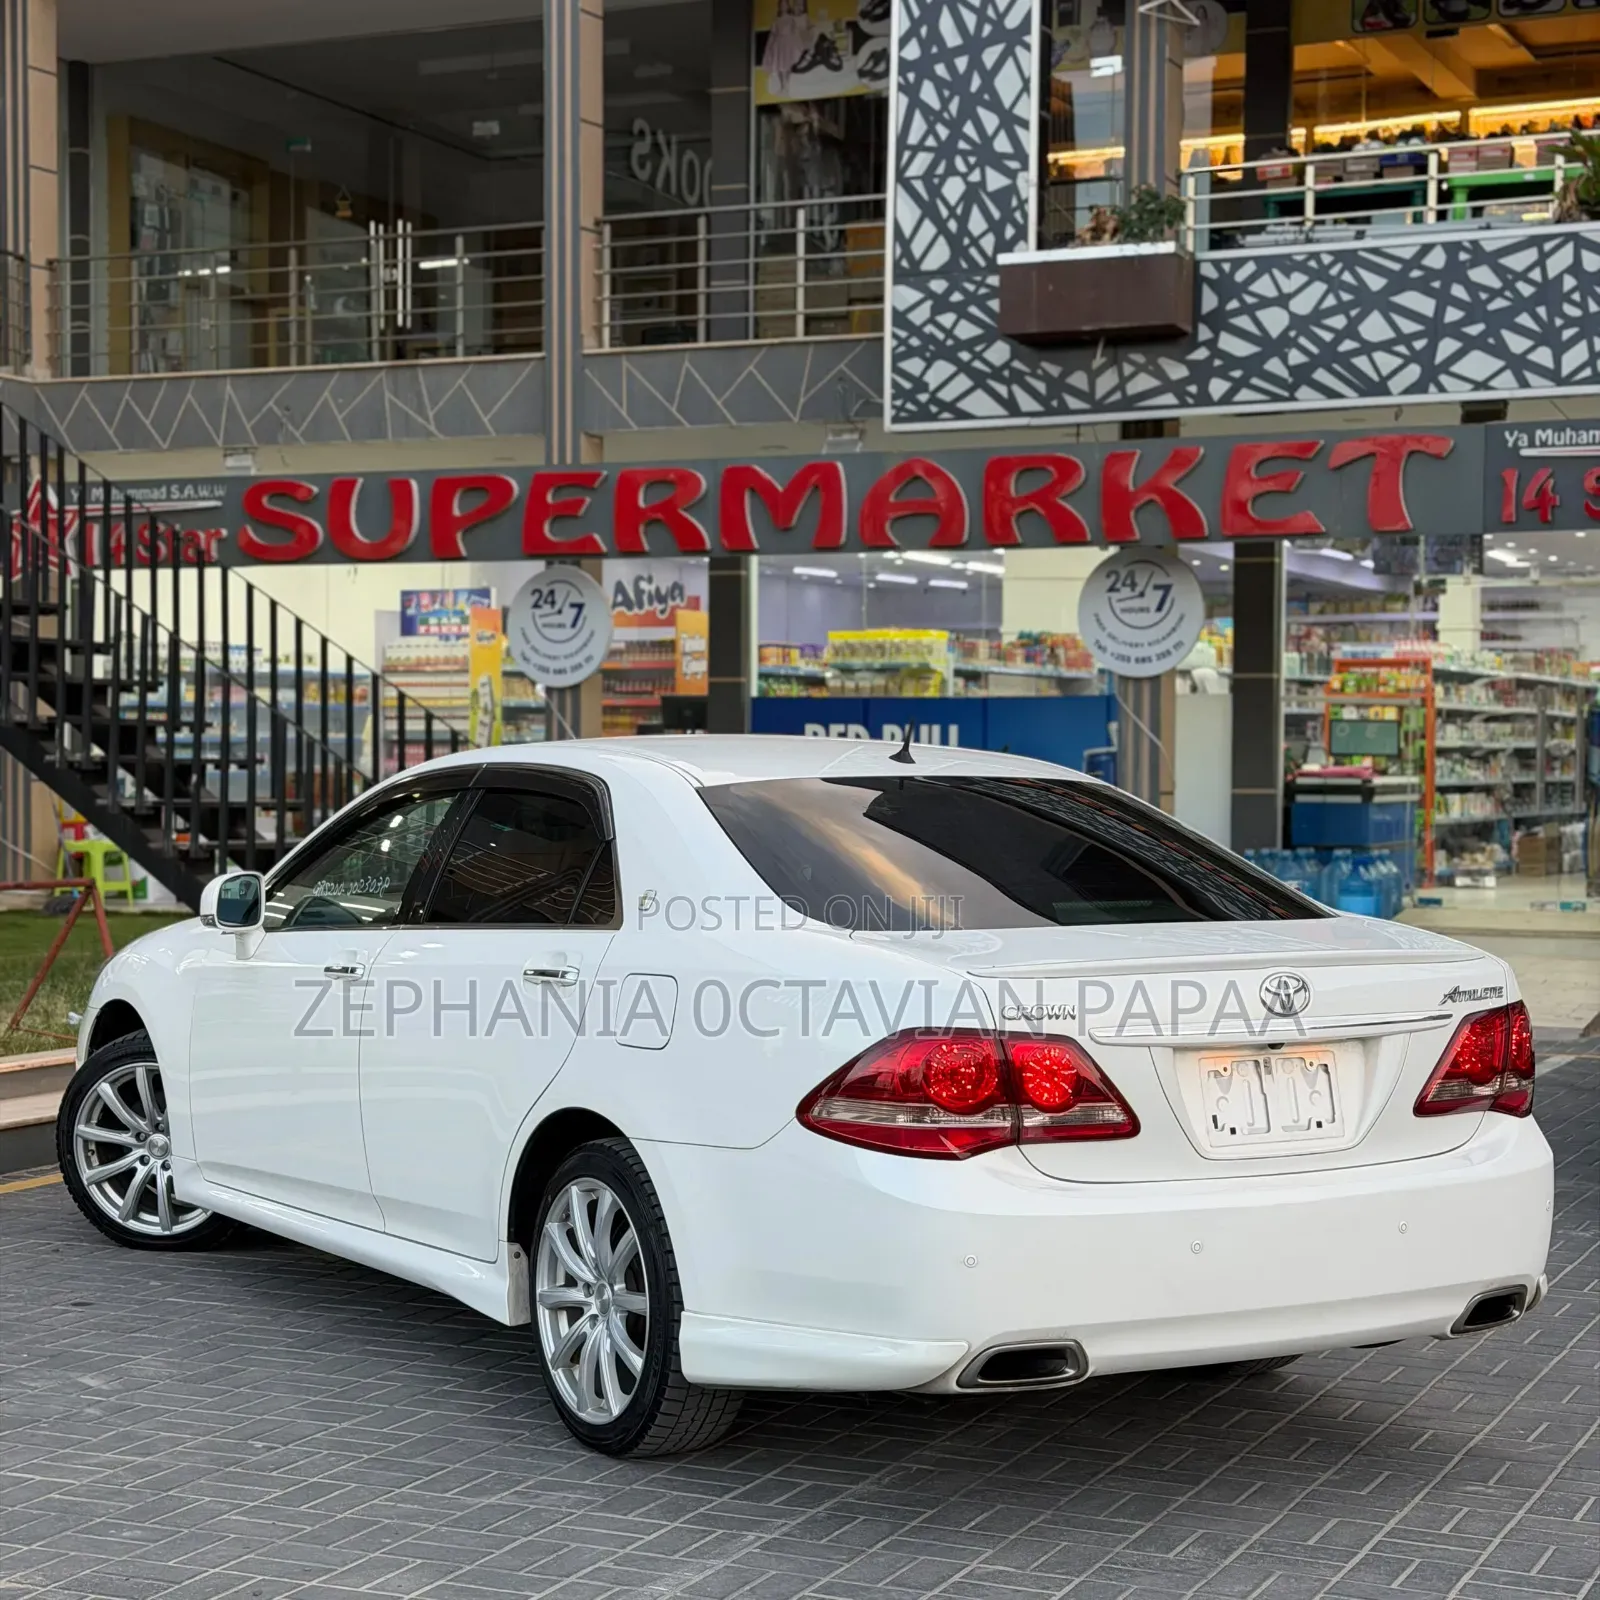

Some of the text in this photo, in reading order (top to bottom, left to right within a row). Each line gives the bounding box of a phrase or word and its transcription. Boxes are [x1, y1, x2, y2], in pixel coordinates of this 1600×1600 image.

[1504, 430, 1528, 447] Ya
[237, 434, 1453, 562] SUPERMARKET
[1501, 467, 1560, 523] 14
[611, 573, 686, 617] Afiya
[1001, 1003, 1078, 1021] CROWN
